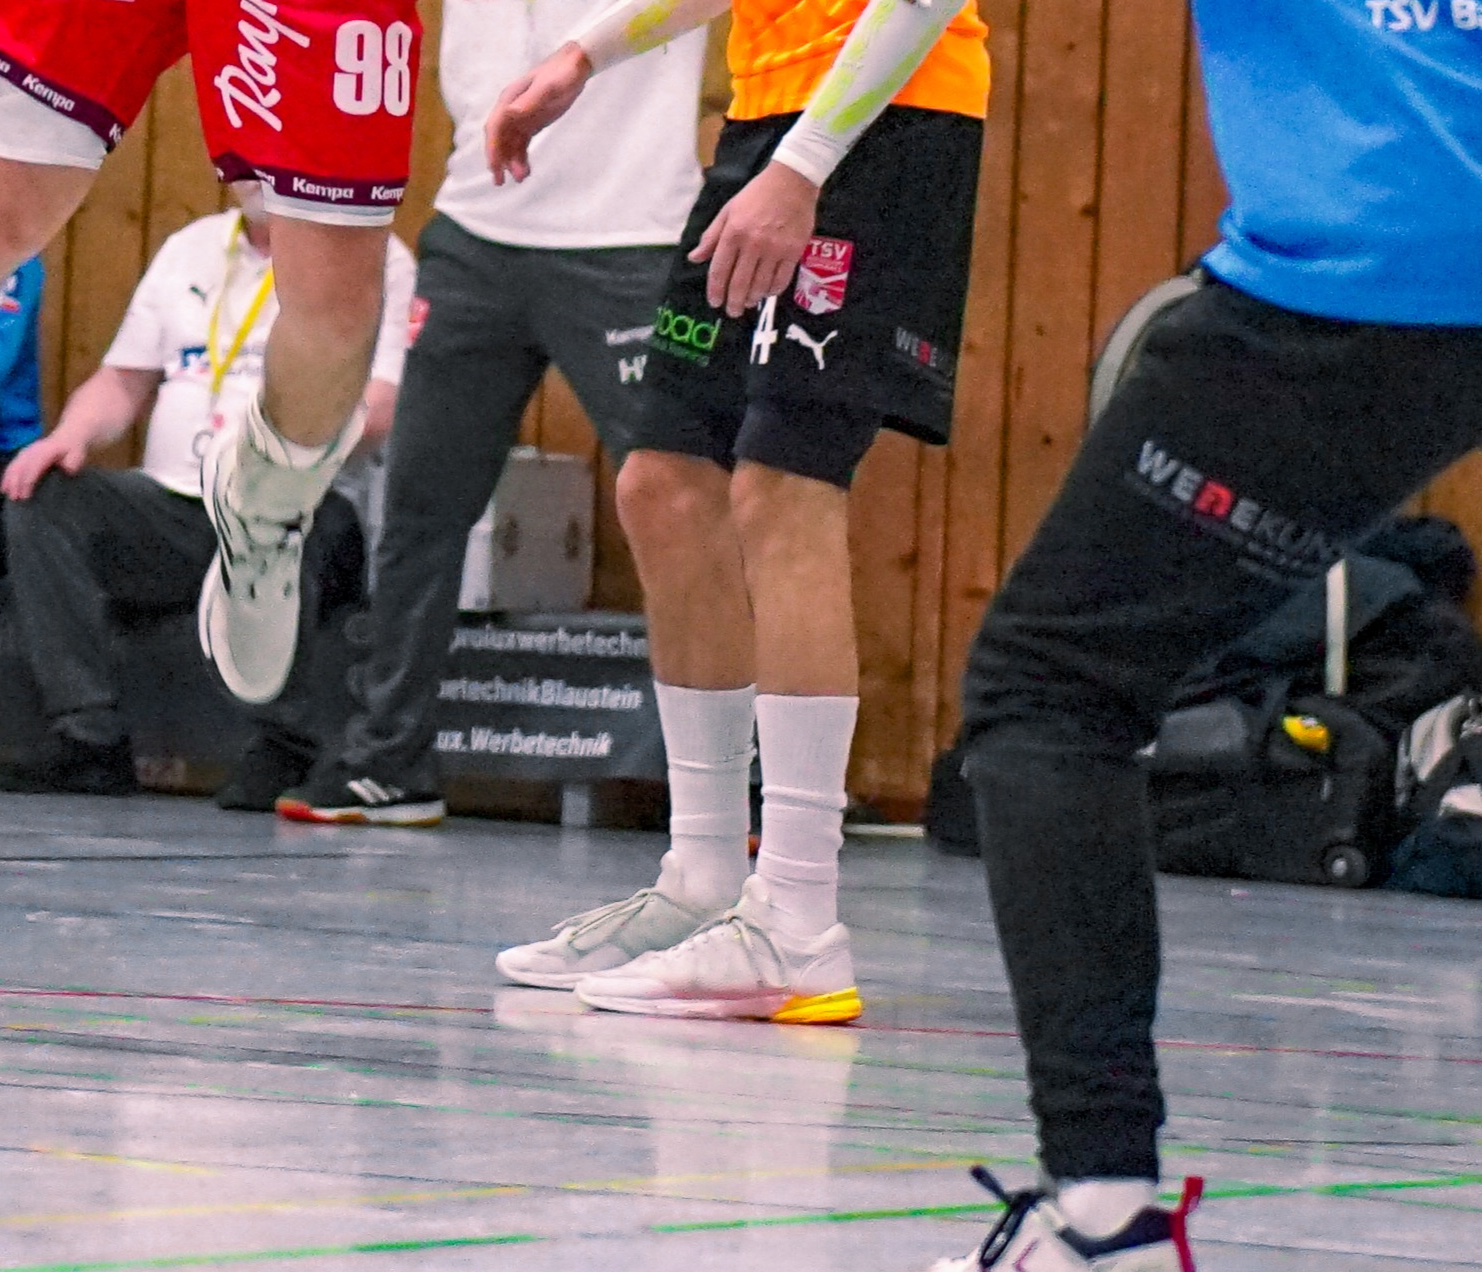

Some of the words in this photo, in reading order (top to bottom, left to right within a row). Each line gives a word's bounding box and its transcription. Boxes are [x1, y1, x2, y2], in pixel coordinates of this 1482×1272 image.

[332, 19, 413, 118] 98
[21, 73, 76, 112] Kempa
[292, 176, 355, 202] Kempa
[810, 239, 850, 260] TSV
